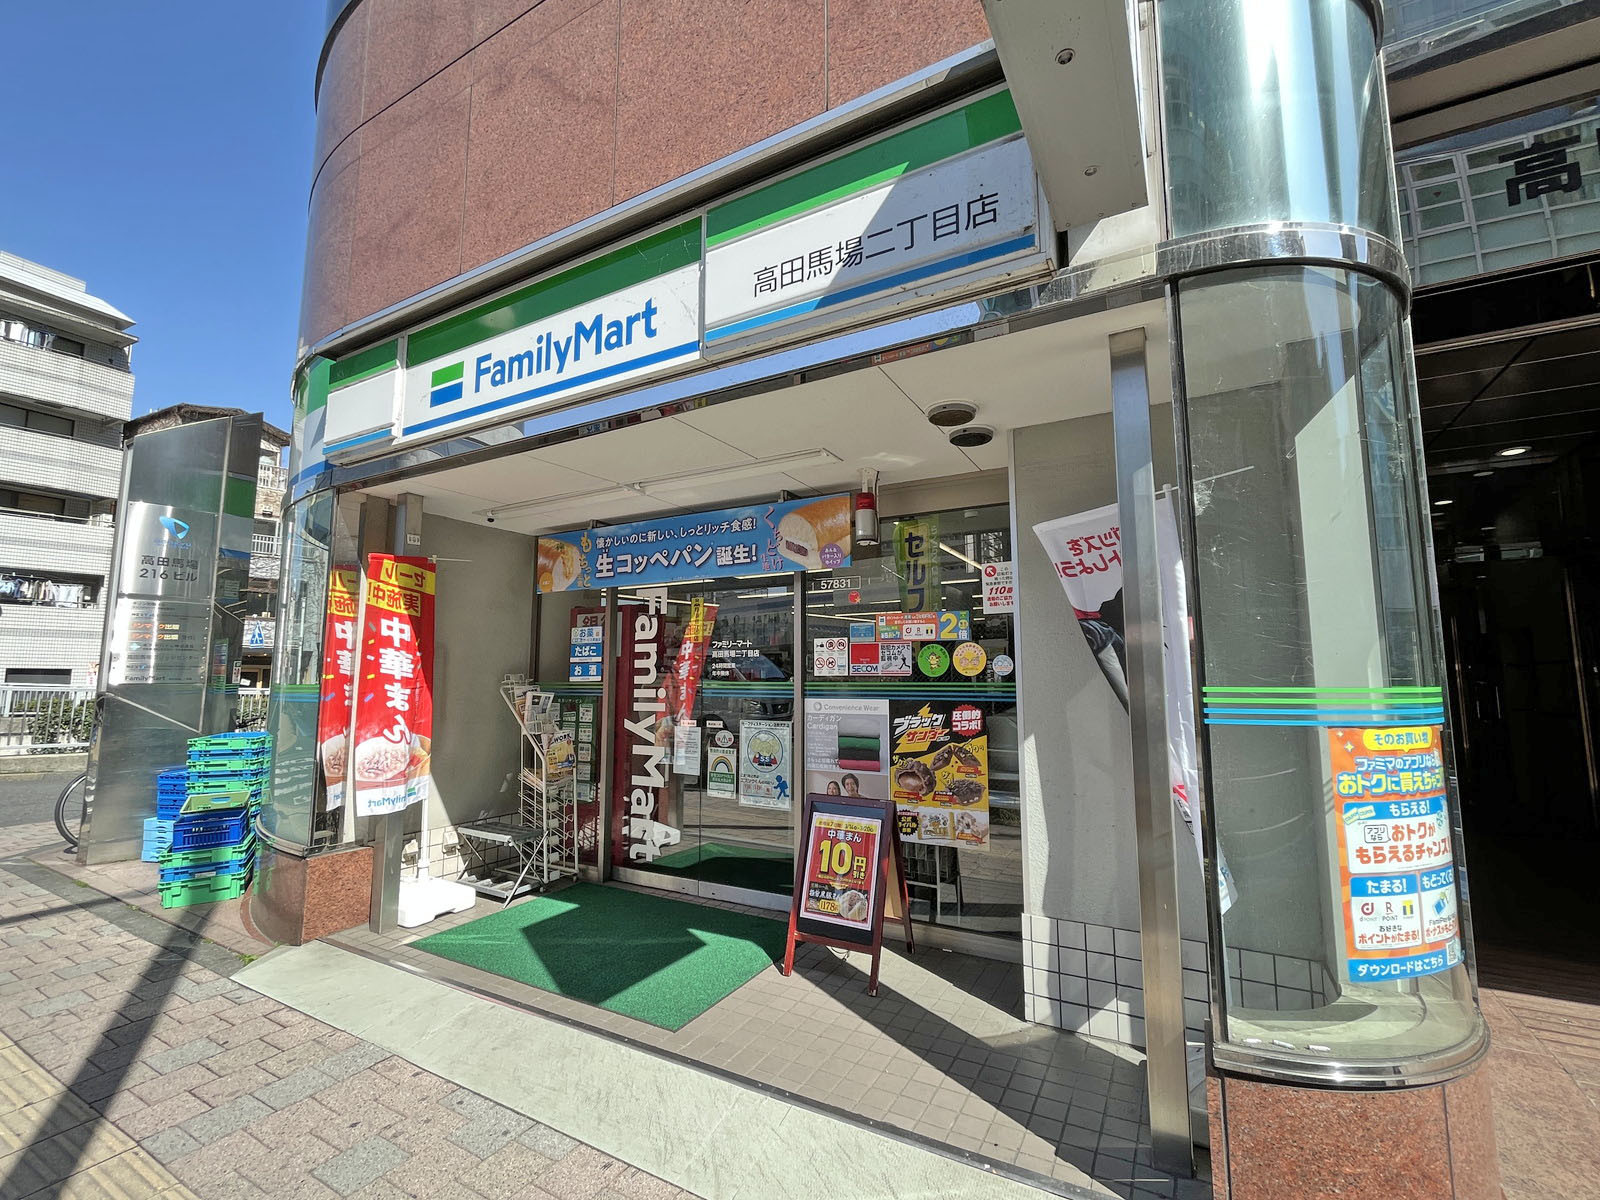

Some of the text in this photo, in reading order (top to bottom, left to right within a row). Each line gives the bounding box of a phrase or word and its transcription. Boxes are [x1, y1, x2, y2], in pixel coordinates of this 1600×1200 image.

[752, 193, 999, 298] 高田馬場二丁目店
[474, 298, 659, 394] FamilyMart
[141, 555, 199, 570] 高田馬場
[139, 568, 198, 582] 216 ビル
[820, 579, 851, 590] 57831
[574, 646, 597, 656] たばこ
[711, 640, 753, 649] ファミリーマート
[851, 665, 879, 673] SECOM
[823, 703, 880, 712] Convenience Wear
[807, 722, 838, 730] Cardigan
[893, 713, 946, 738] ブラック
[952, 721, 981, 731] コラボ!
[1389, 800, 1431, 817] もらえる!
[828, 829, 862, 843] 中華まん
[1366, 827, 1386, 835] アプリ
[1392, 822, 1436, 843] おトクが
[1366, 878, 1408, 895] たまる!
[1358, 930, 1420, 945] ポイントがたまる!
[1357, 955, 1444, 977] ダウンロードはこちら
